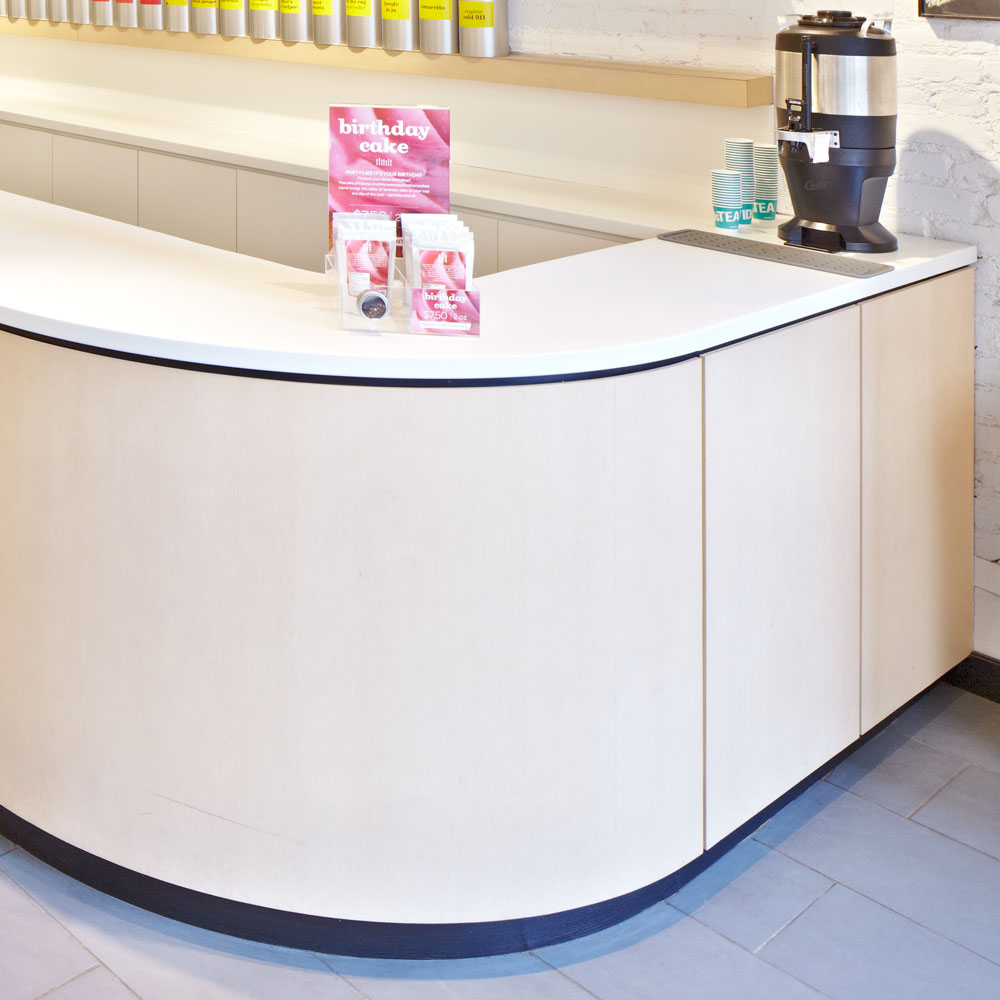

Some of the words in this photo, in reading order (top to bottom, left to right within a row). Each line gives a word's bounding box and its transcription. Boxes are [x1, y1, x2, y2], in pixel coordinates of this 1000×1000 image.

[338, 118, 431, 140] birthday
[359, 137, 409, 154] cake
[424, 292, 467, 303] birthday
[434, 302, 457, 310] cake
